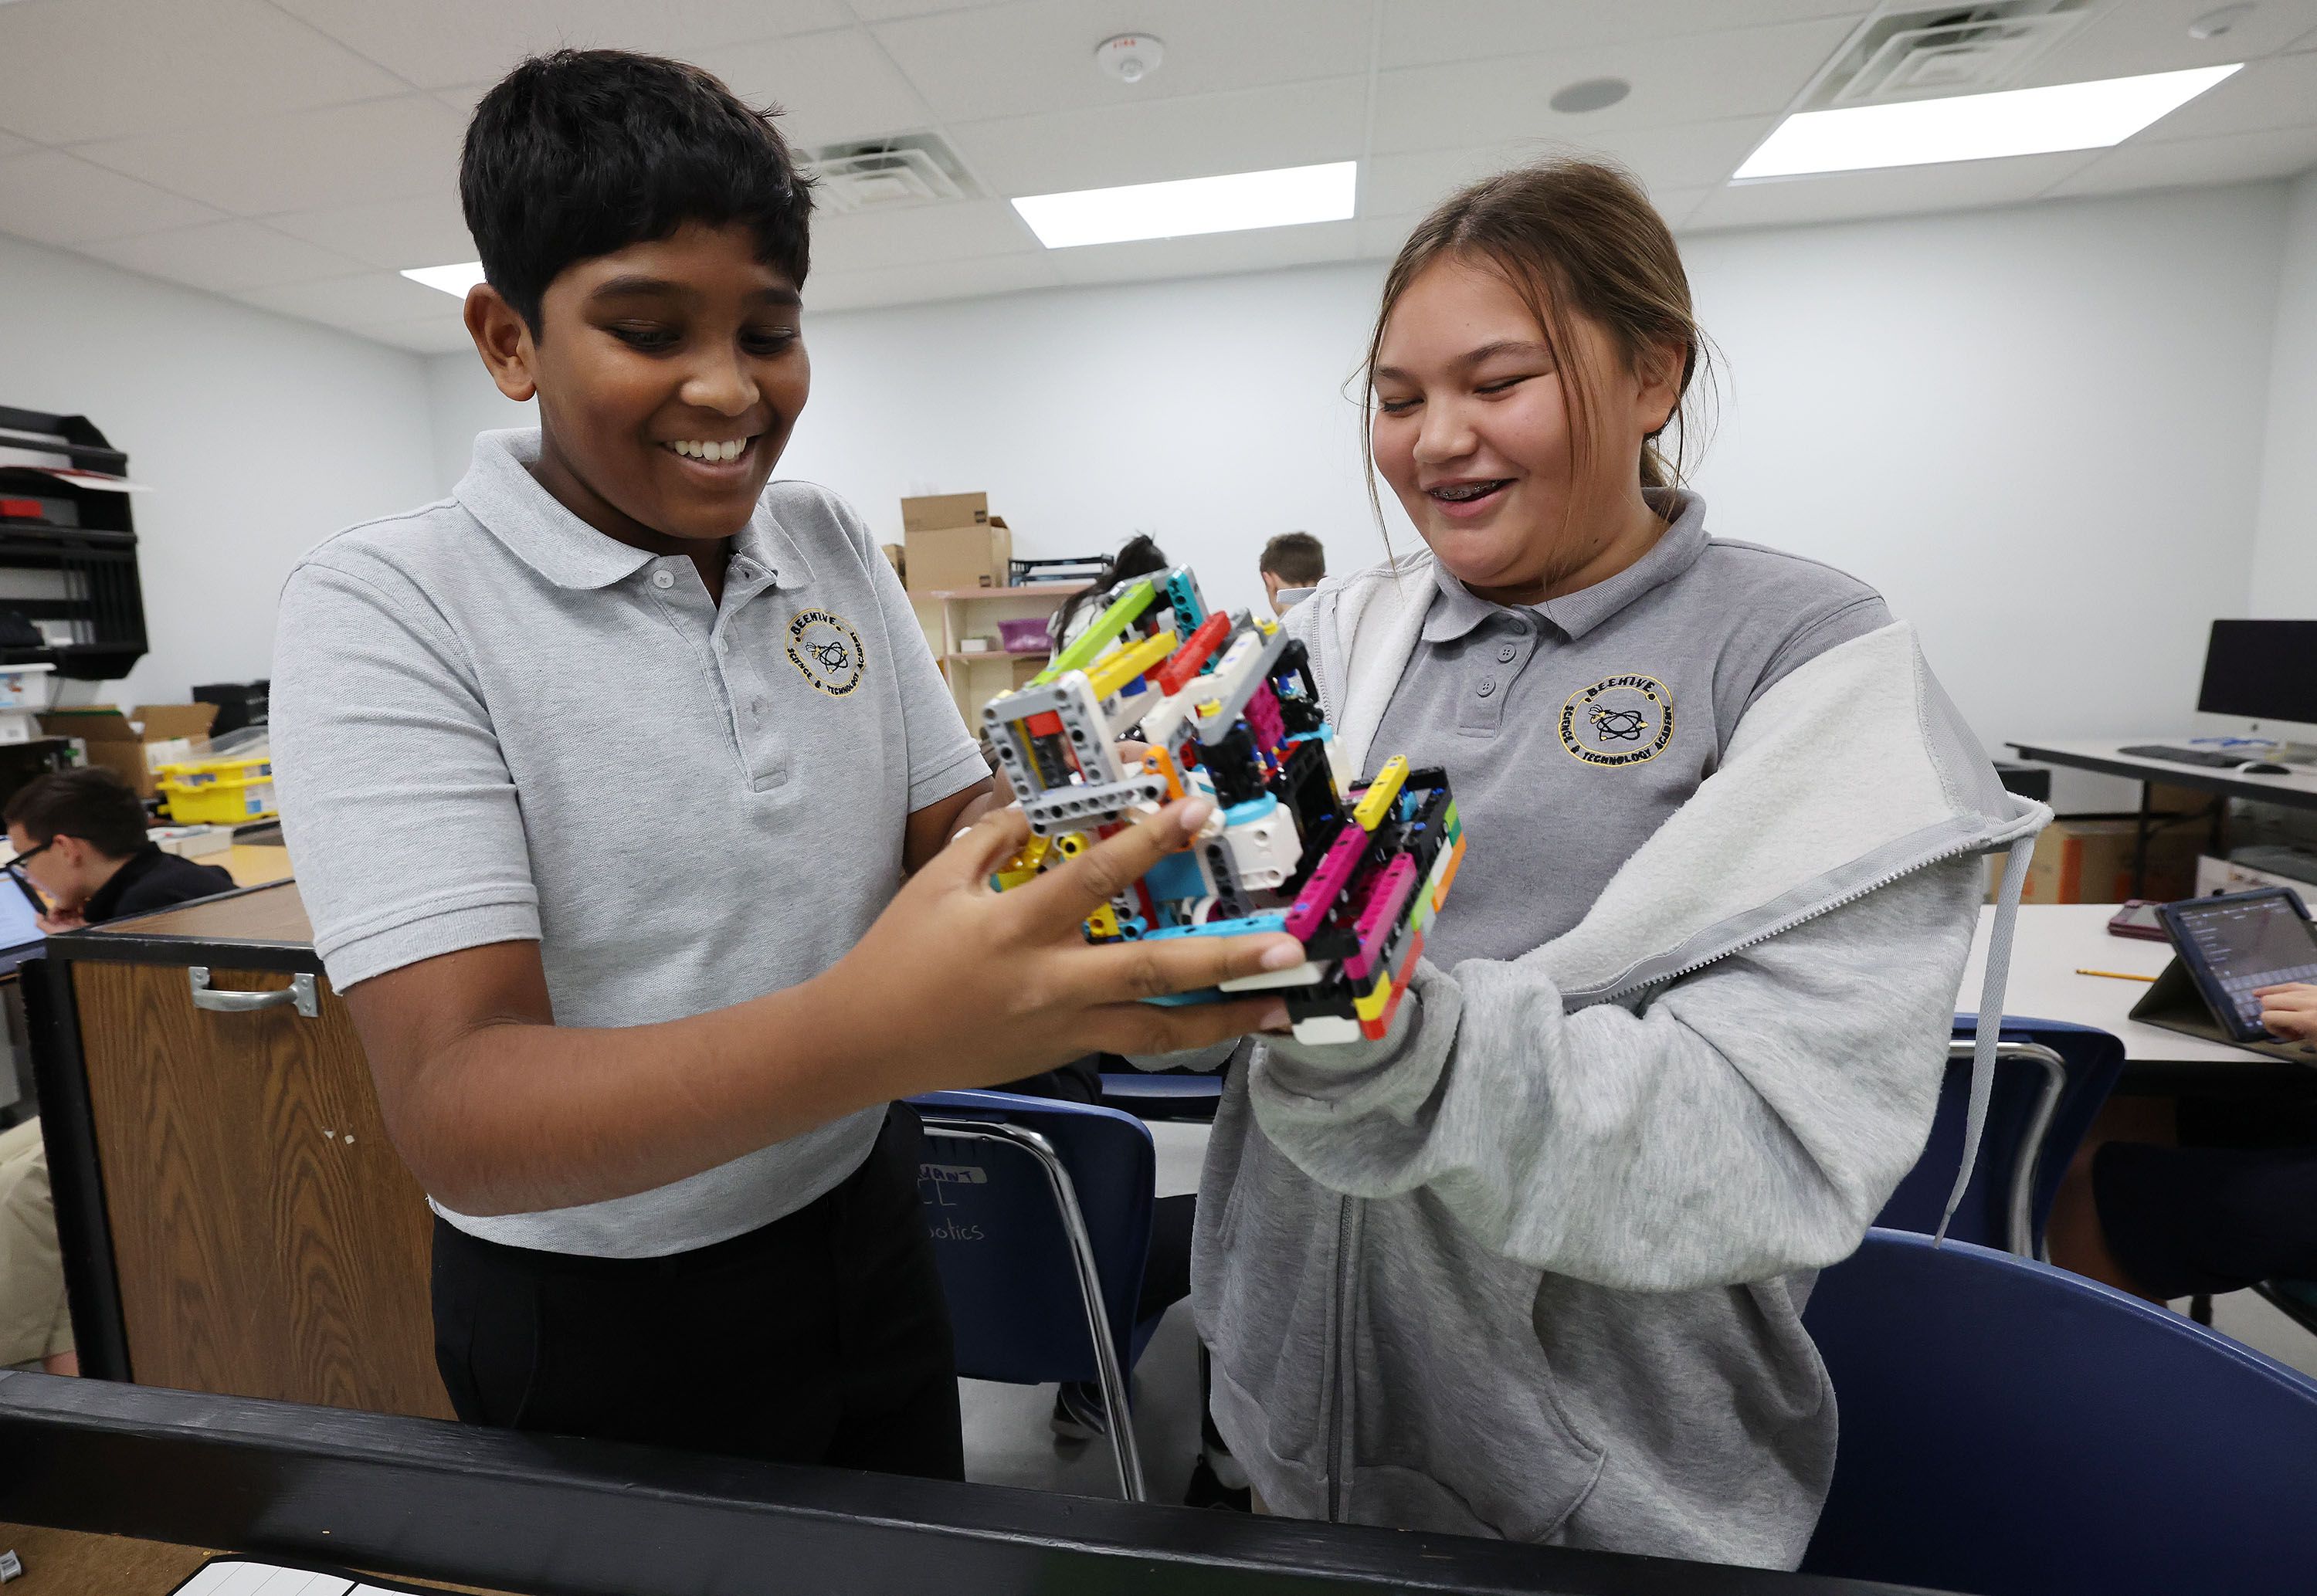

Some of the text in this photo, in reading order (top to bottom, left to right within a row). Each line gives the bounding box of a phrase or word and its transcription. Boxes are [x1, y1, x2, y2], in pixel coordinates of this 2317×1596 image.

[791, 612, 836, 635] BEEHIVE
[787, 648, 812, 679] SCIENCE
[815, 680, 822, 689] &
[827, 672, 859, 695] TECHNOLOGY
[1586, 676, 1656, 697] BEEHIVE
[1561, 705, 1672, 765] SCIENCE & TECHNOLOGY ACADEMY
